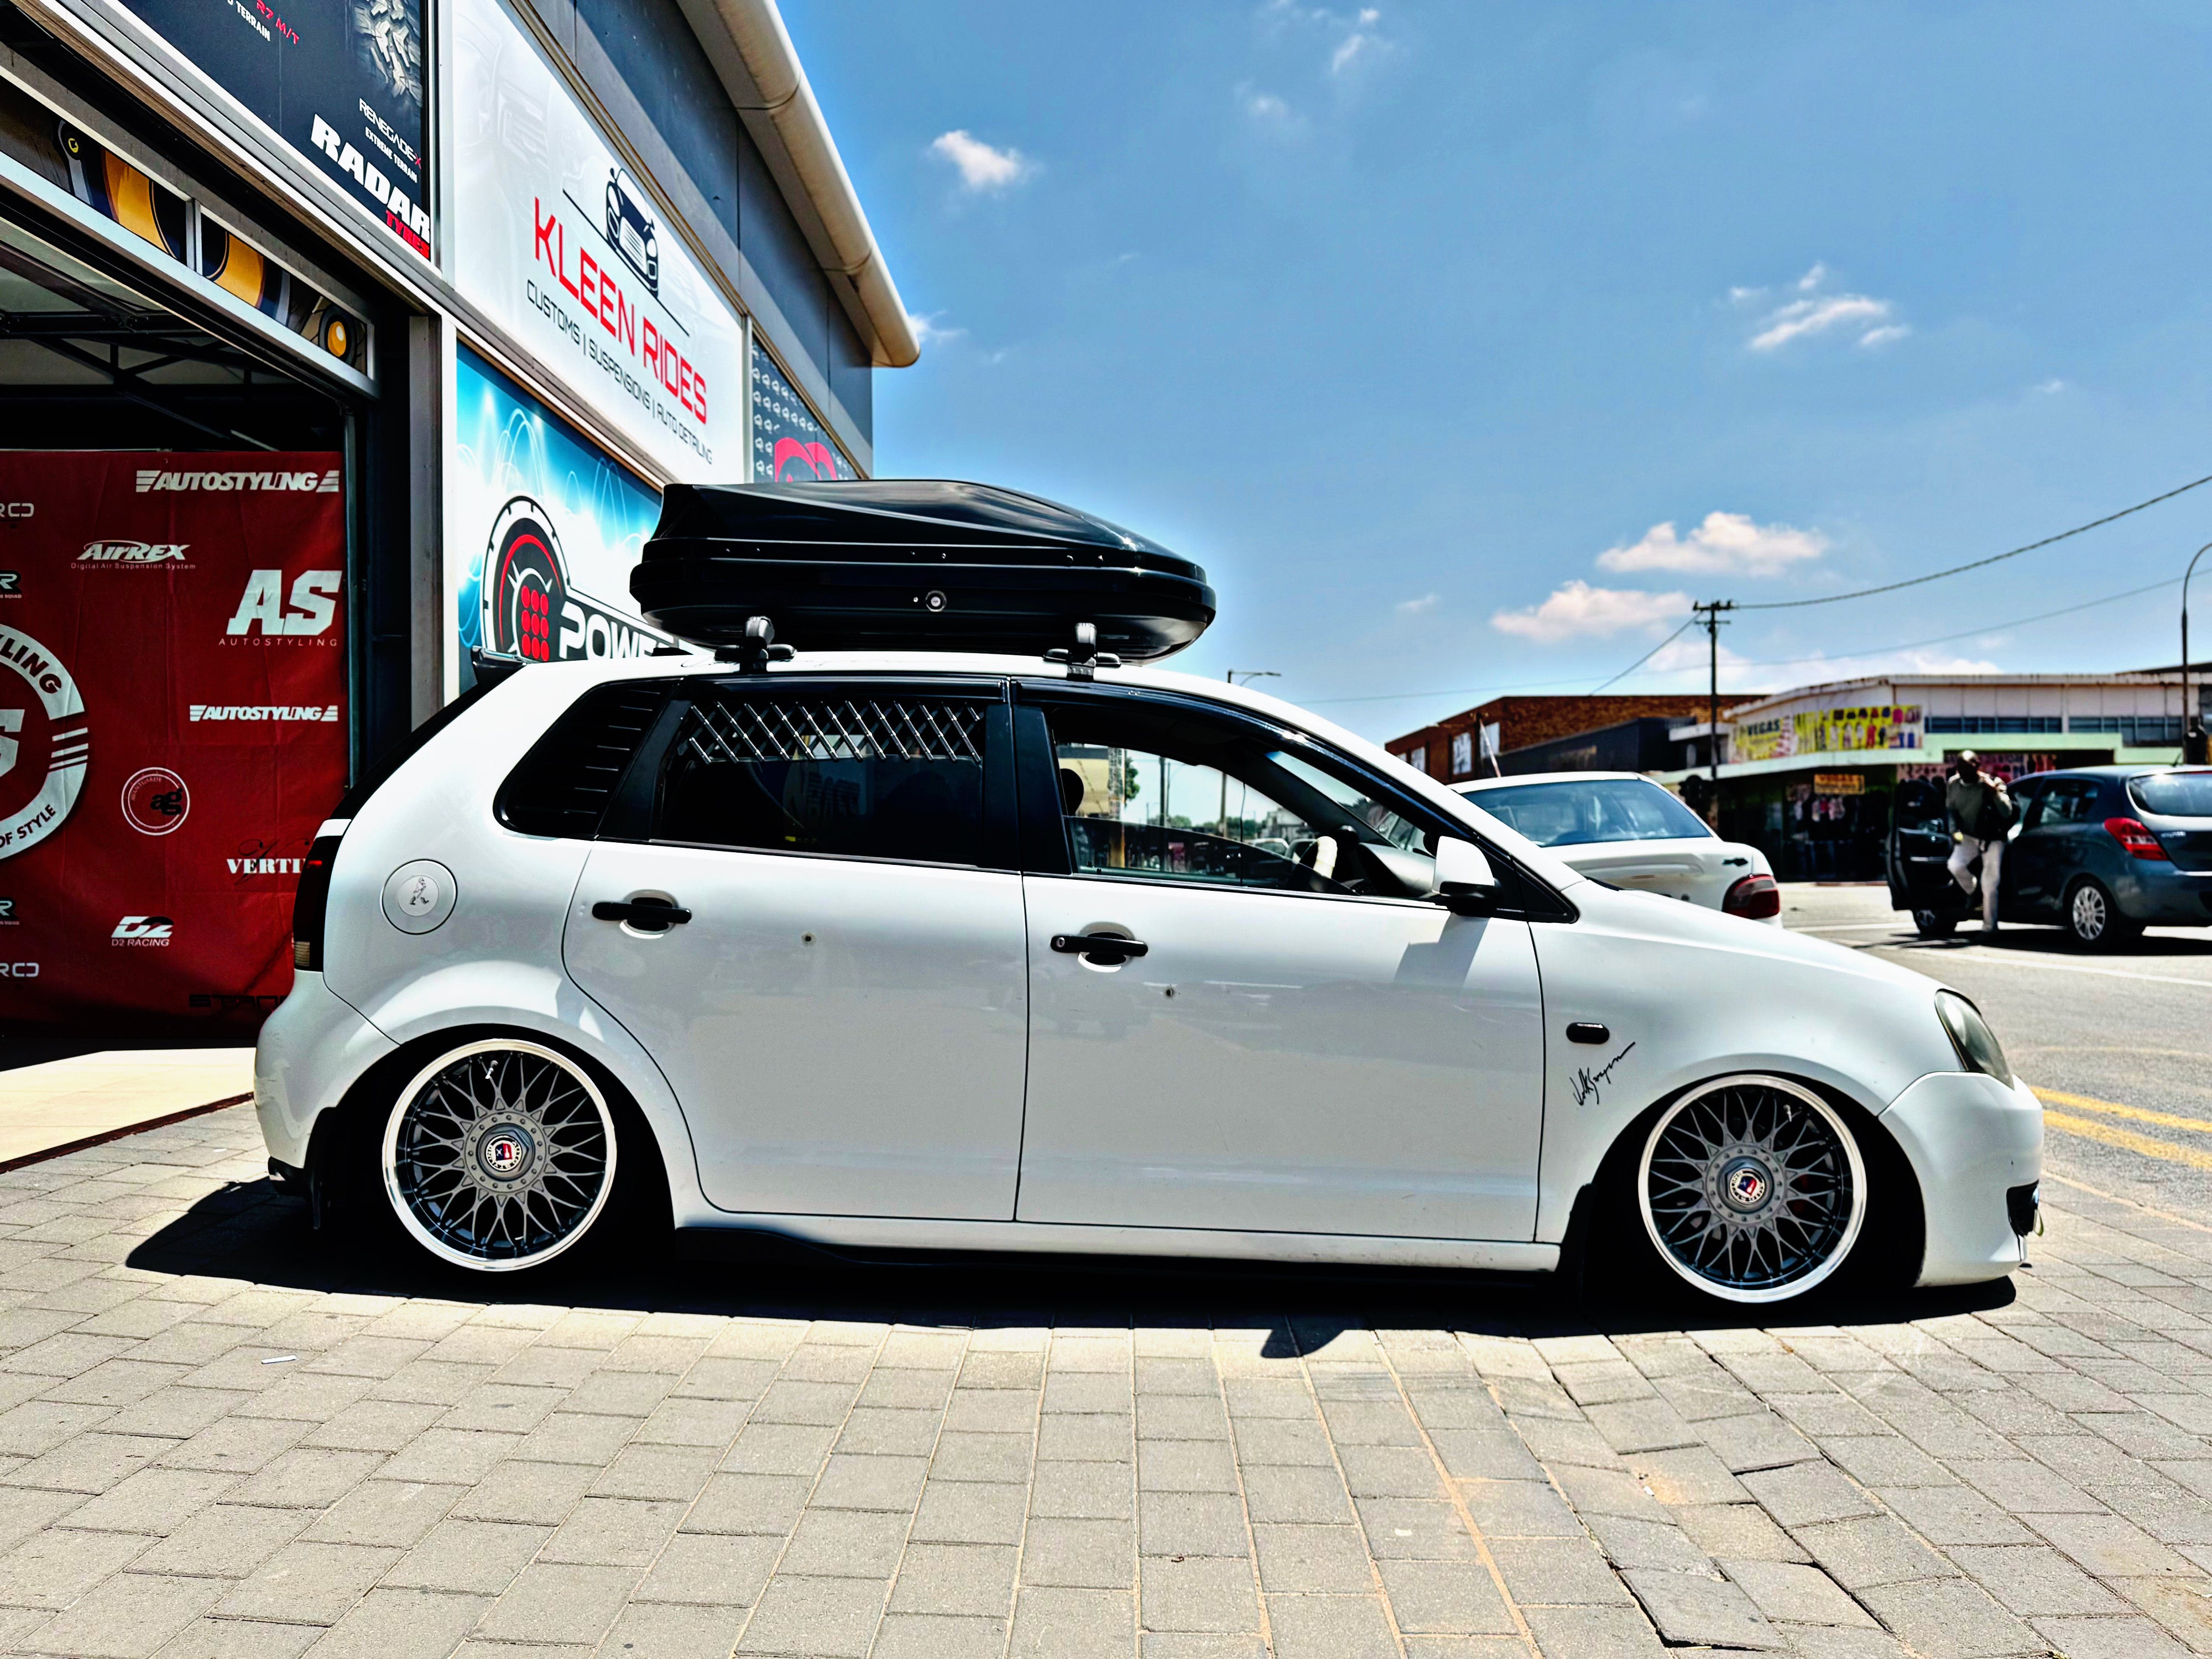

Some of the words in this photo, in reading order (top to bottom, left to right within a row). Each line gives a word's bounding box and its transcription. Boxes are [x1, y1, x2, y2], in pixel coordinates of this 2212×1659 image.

[236, 1, 270, 41] TERRAIN
[275, 17, 300, 44] M/T
[365, 126, 393, 160] EXTREME
[393, 153, 418, 183] TERRAIN
[311, 113, 430, 243] RADAR
[386, 210, 430, 259] TYRES
[535, 196, 635, 356] KLEEN
[643, 316, 707, 425] RIDES
[527, 279, 580, 346] CUSTOMS
[589, 339, 651, 410] SUSPENSIONS
[657, 409, 678, 435] AUTO
[678, 421, 713, 465] DETAILING
[153, 472, 319, 491] AUTOSTYLING
[226, 569, 342, 635] AS
[218, 638, 337, 646] AUTOSTYLING
[202, 706, 322, 720] AUTOSTYLING
[19, 804, 56, 839] STYLE
[227, 858, 306, 874] VERTI
[127, 938, 170, 947] RACING
